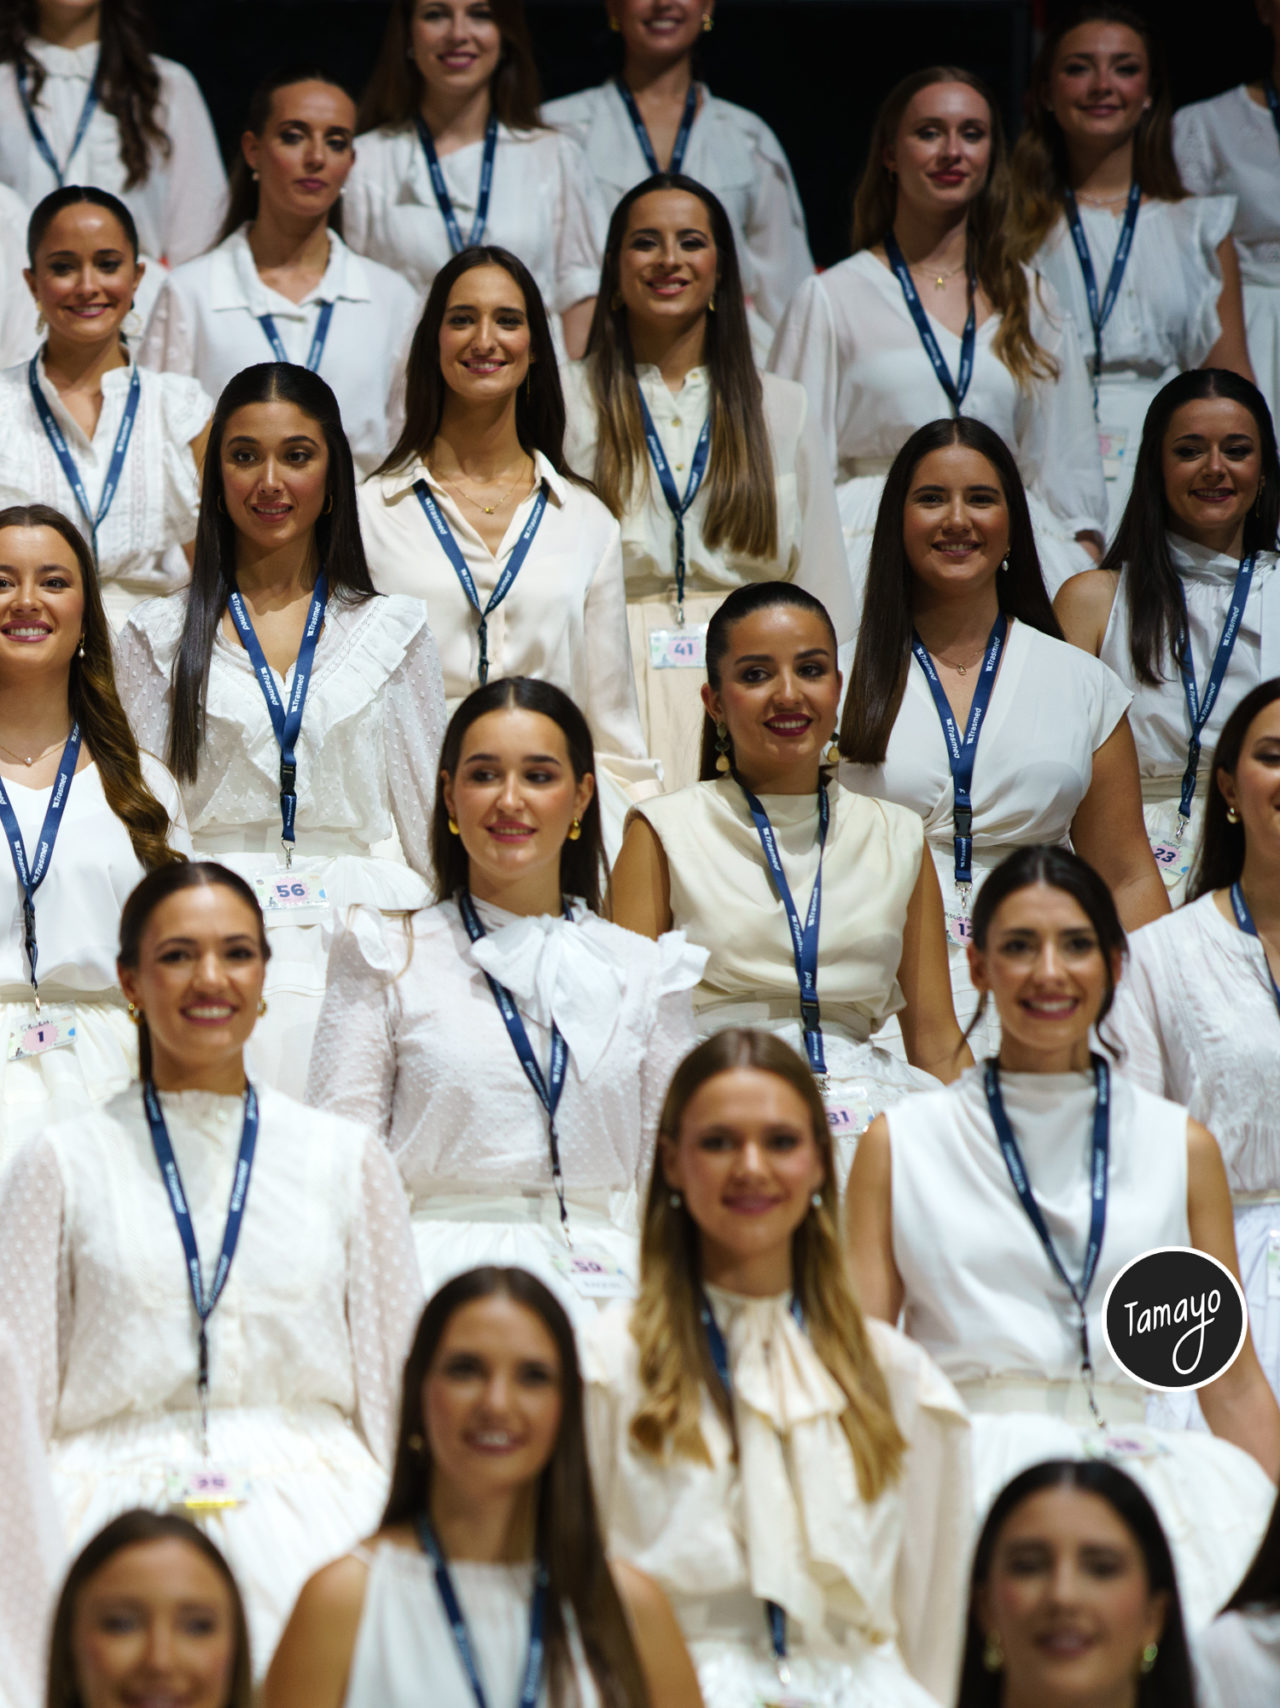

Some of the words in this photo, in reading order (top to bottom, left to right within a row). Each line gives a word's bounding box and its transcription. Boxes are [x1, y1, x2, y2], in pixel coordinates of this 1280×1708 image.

[428, 500, 448, 535] Trasmed
[493, 570, 511, 601] Trasmed
[233, 600, 250, 631] Trasmed
[310, 601, 321, 631] Trasmed
[1225, 606, 1239, 637] Trasmed
[674, 643, 693, 656] 41
[988, 637, 1001, 668] Trasmed
[263, 673, 279, 706] Trasmed
[293, 674, 305, 706] Trasmed
[1202, 682, 1216, 716] Trasmed
[969, 707, 982, 738] Trasmed
[55, 772, 68, 802] Trasmed
[35, 841, 48, 877] Trasmed
[1154, 848, 1176, 863] 23
[276, 883, 305, 898] 56
[37, 1031, 44, 1042] 1
